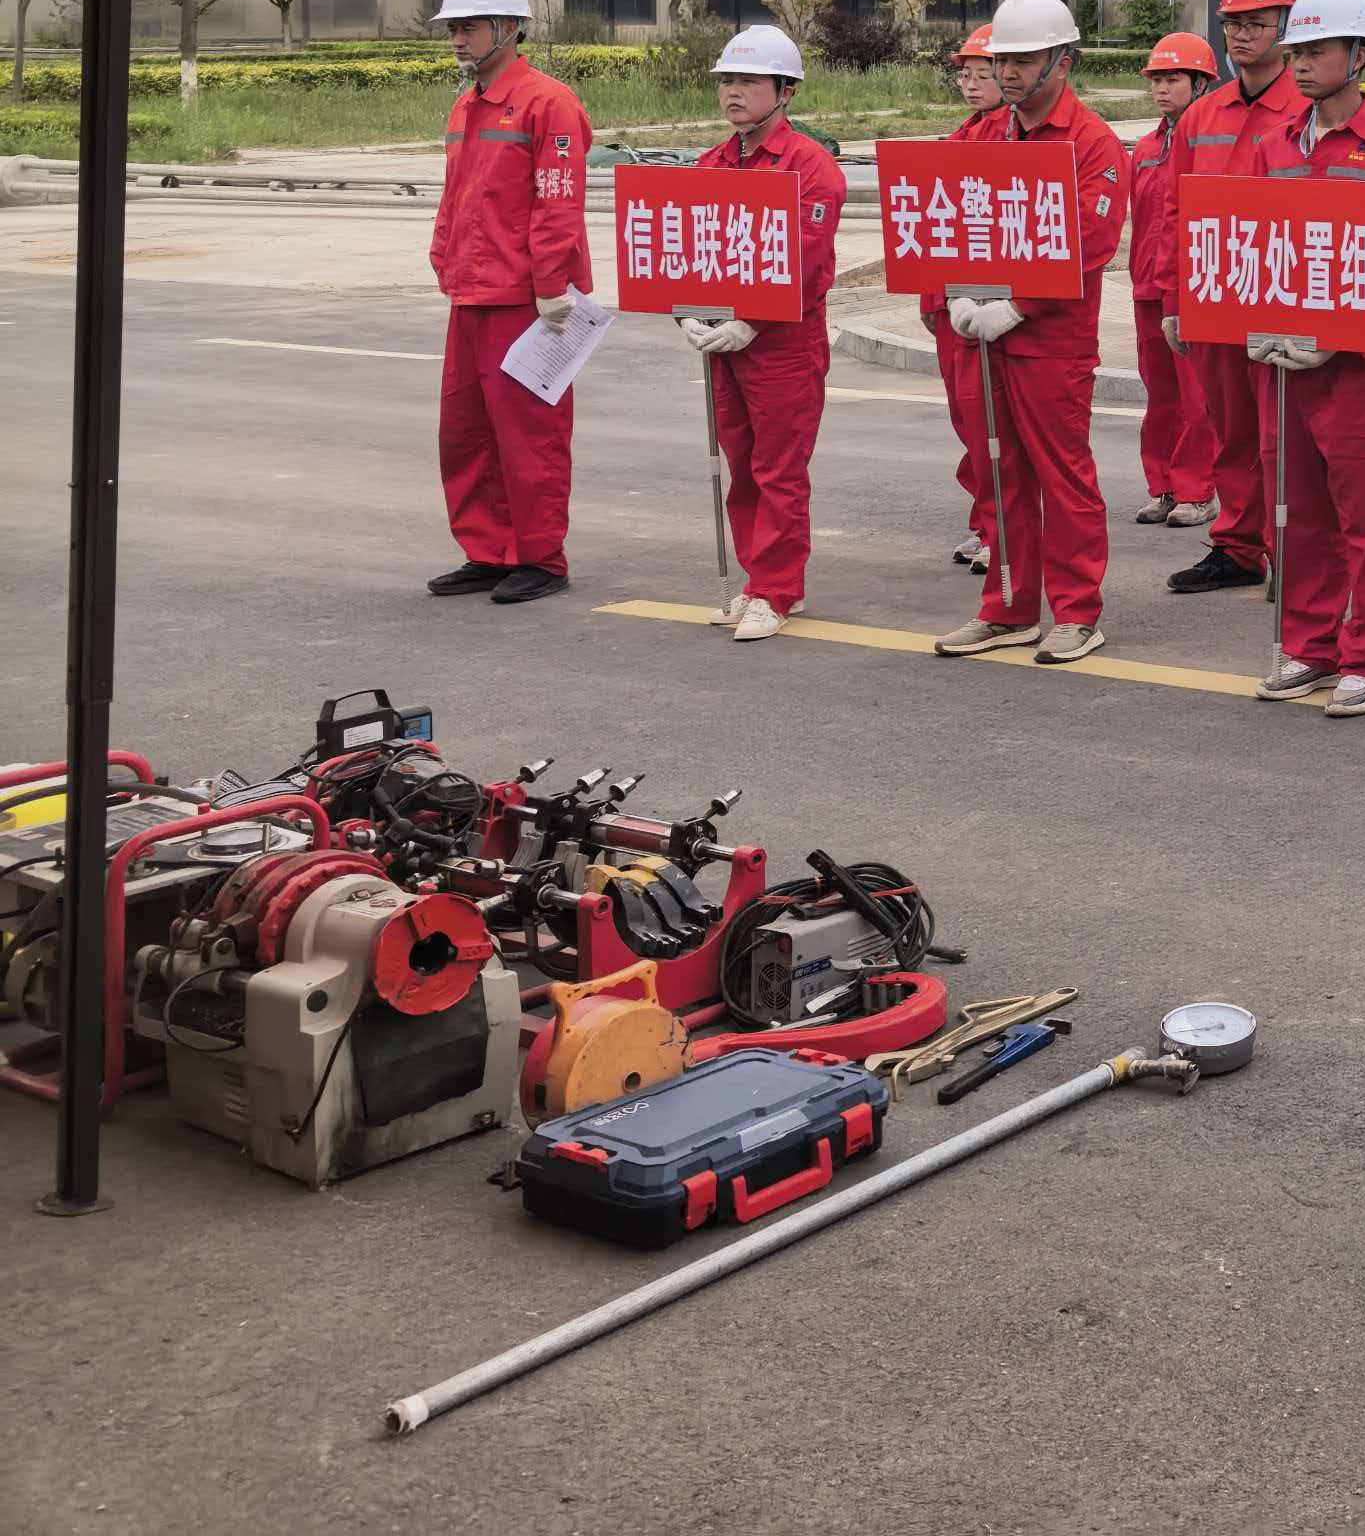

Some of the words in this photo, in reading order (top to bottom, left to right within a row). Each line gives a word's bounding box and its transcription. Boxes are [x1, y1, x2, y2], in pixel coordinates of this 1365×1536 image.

[623, 198, 792, 286] 信息联络组
[890, 175, 1071, 262] 安全警戒组
